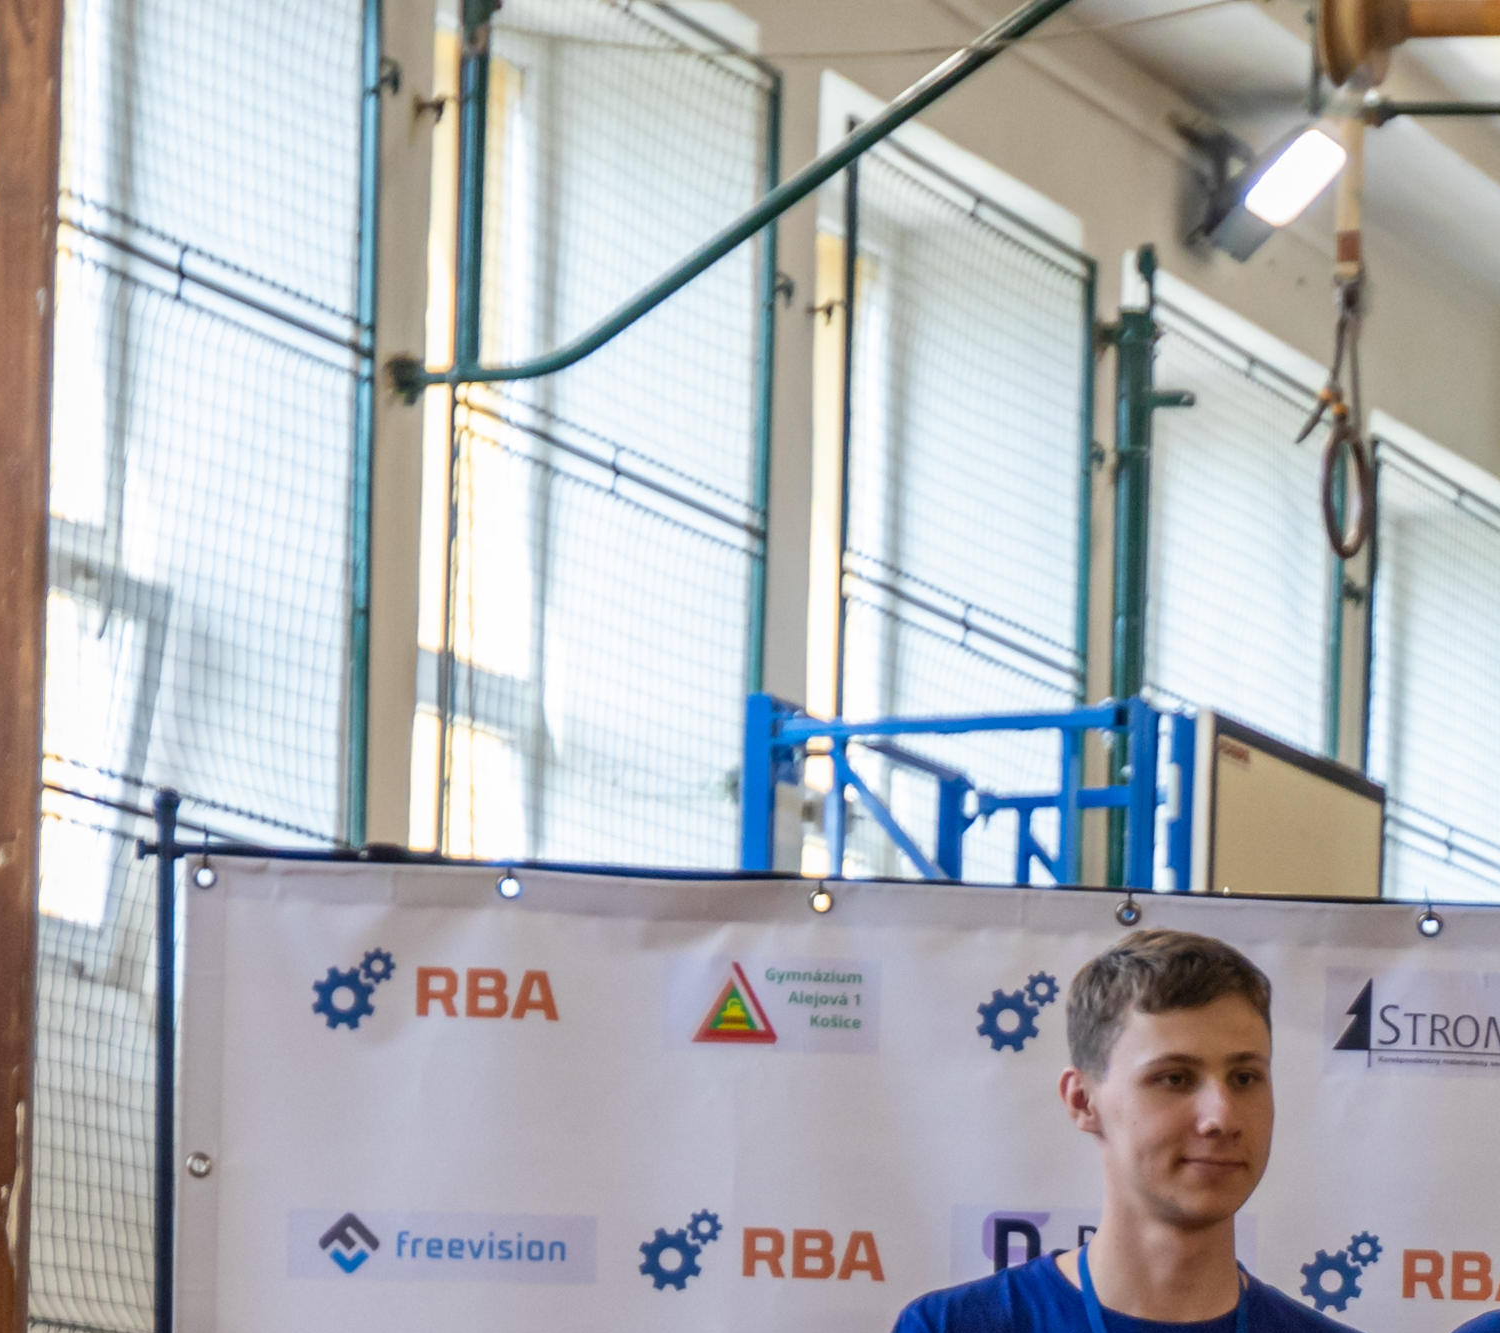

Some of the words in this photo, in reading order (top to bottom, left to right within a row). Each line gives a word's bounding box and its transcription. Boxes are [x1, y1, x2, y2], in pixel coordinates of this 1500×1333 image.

[764, 968, 863, 987] Gymnázium
[416, 966, 559, 1021] RBA
[787, 988, 851, 1008] Alejová
[854, 993, 862, 1006] 1
[809, 1012, 862, 1031] Košice
[395, 1230, 568, 1262] freevision
[742, 1228, 886, 1282] RBA
